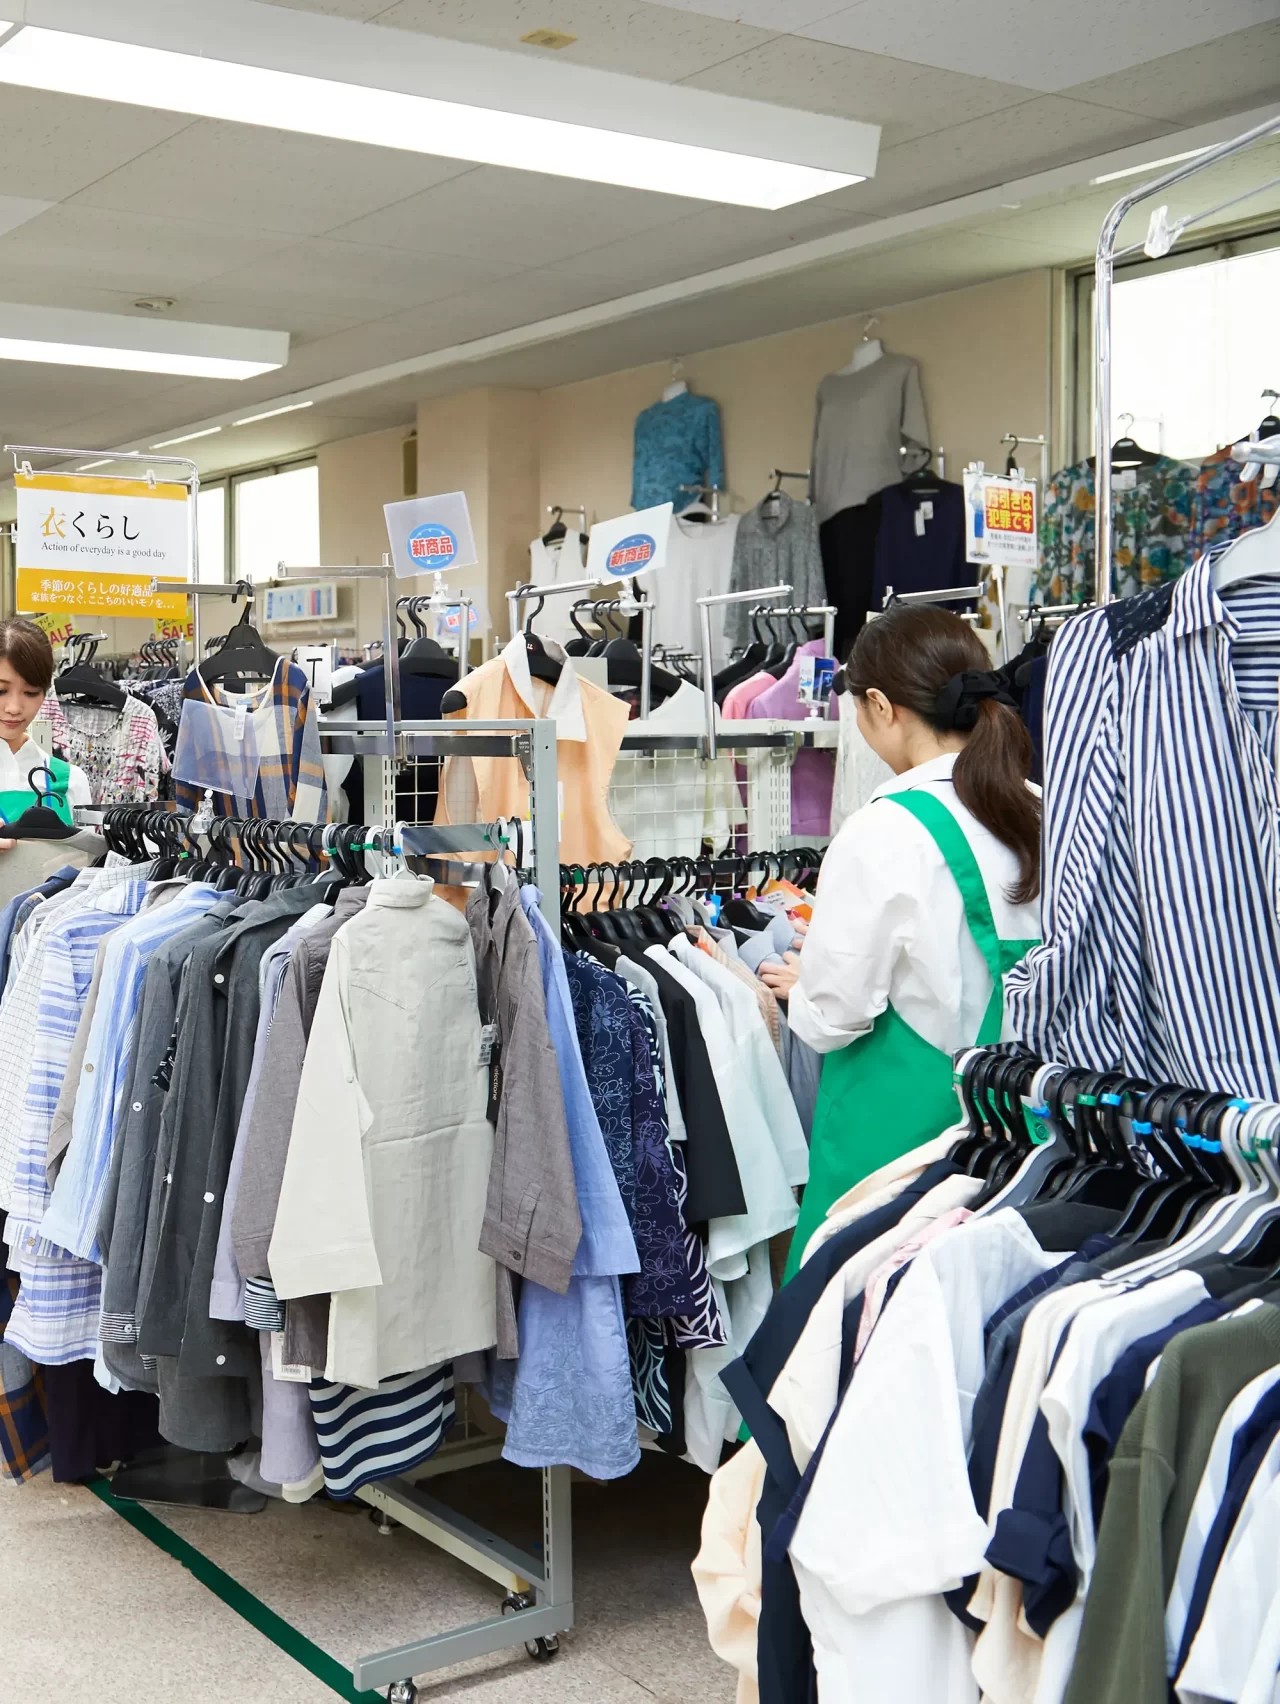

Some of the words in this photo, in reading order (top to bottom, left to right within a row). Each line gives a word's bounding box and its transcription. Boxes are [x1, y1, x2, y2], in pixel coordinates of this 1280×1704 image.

[986, 488, 1032, 511] 万引きは
[40, 506, 141, 541] 衣くらし
[988, 508, 1033, 531] 犯罪です
[41, 541, 68, 552] Action
[70, 543, 80, 552] of
[80, 545, 116, 557] everyday
[117, 545, 125, 555] is
[132, 548, 151, 558] good
[152, 549, 167, 560] day
[410, 536, 454, 557] 新商品
[609, 543, 651, 568] 新商品
[40, 578, 153, 598] 季節のくらしの好適品
[49, 623, 73, 645] ALE
